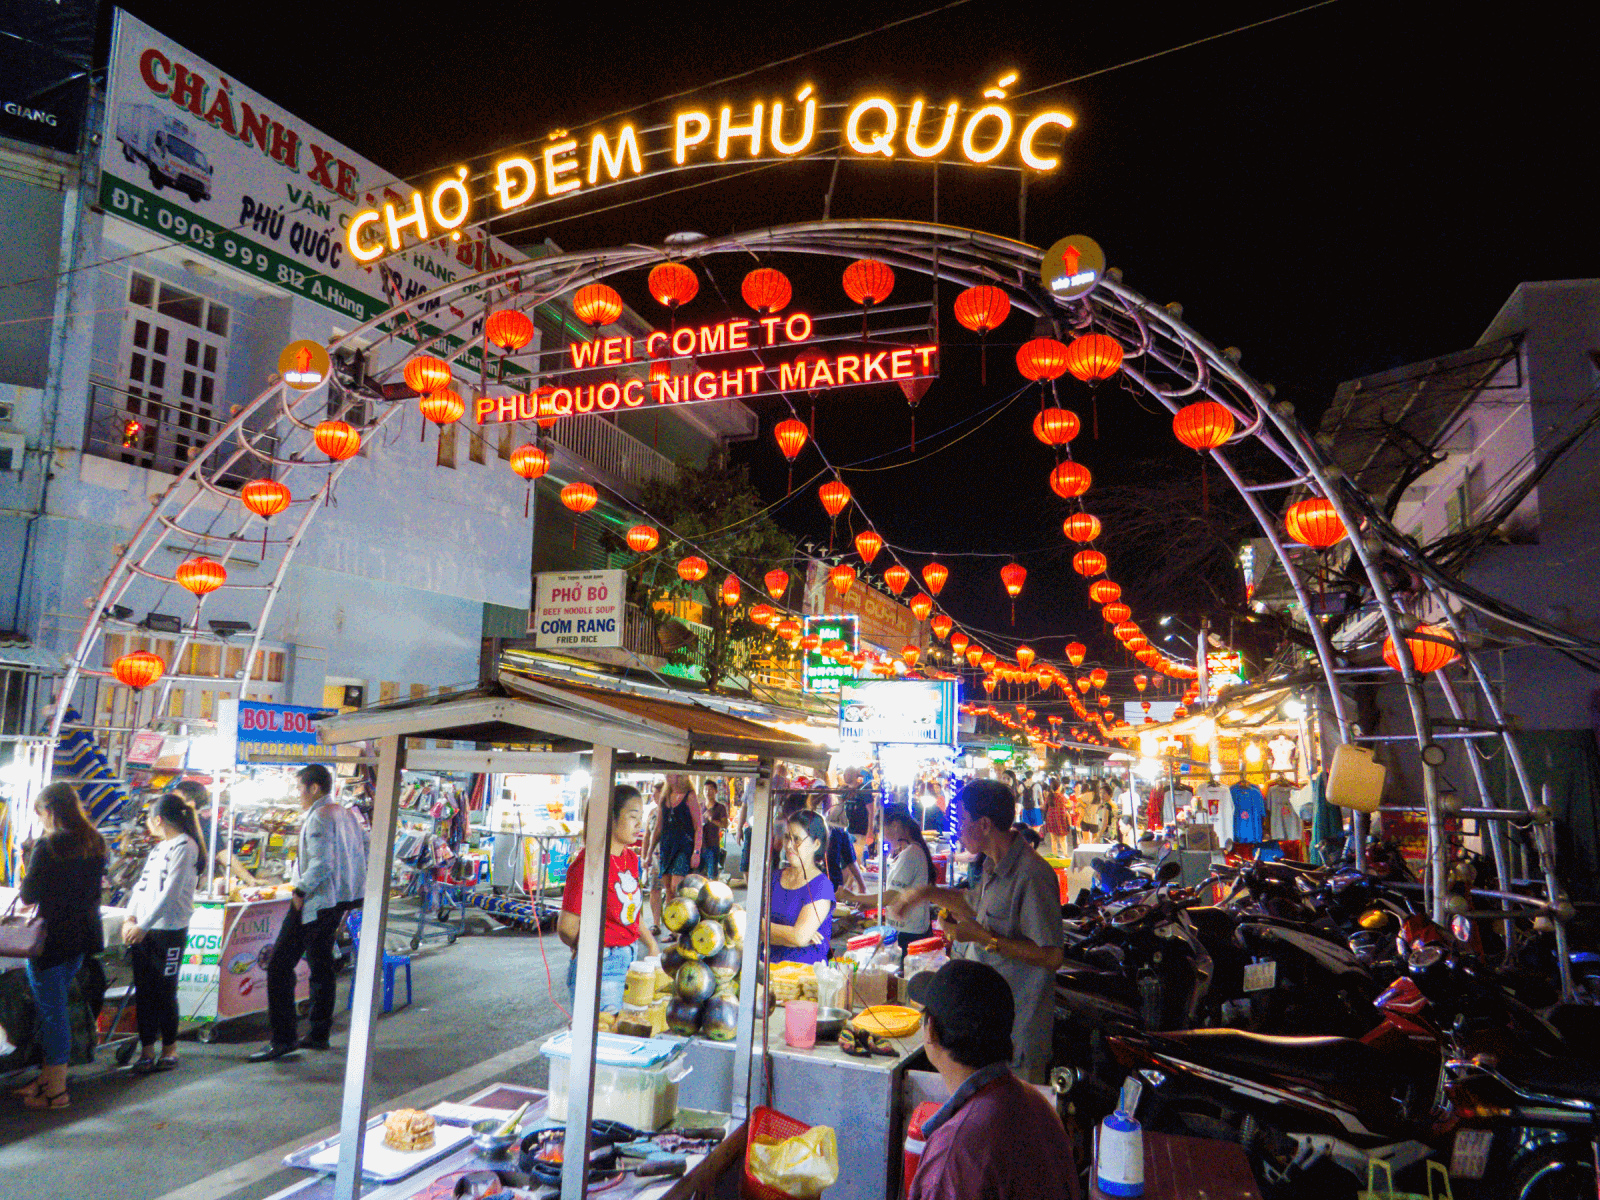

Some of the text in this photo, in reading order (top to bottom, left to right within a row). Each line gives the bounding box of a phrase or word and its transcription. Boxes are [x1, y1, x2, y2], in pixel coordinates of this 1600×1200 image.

[4, 102, 57, 127] GIANG
[139, 48, 360, 202] CHÀNH XE
[346, 166, 470, 263] CHỢ
[493, 127, 642, 211] ĐÊM
[674, 84, 817, 165] PHÚ
[846, 73, 1076, 171] QUỐC
[286, 182, 331, 220] VẬN
[240, 194, 287, 240] PHÚ
[288, 227, 343, 269] QUỐC
[111, 187, 150, 221] ĐT:
[156, 208, 216, 250] 0903
[223, 239, 271, 273] 999
[276, 262, 305, 290] 812
[310, 278, 365, 320] A.Hùng
[570, 313, 812, 369] WELCOME TO
[476, 346, 937, 425] PHU QUOC NIGHT MARKET
[542, 605, 616, 616] BEEF NOODLE SOUP
[551, 581, 608, 602] PHỞ BÒ
[541, 618, 616, 634] CƠM RANG
[556, 635, 598, 644] FRIED RICE
[242, 708, 279, 731] BOL
